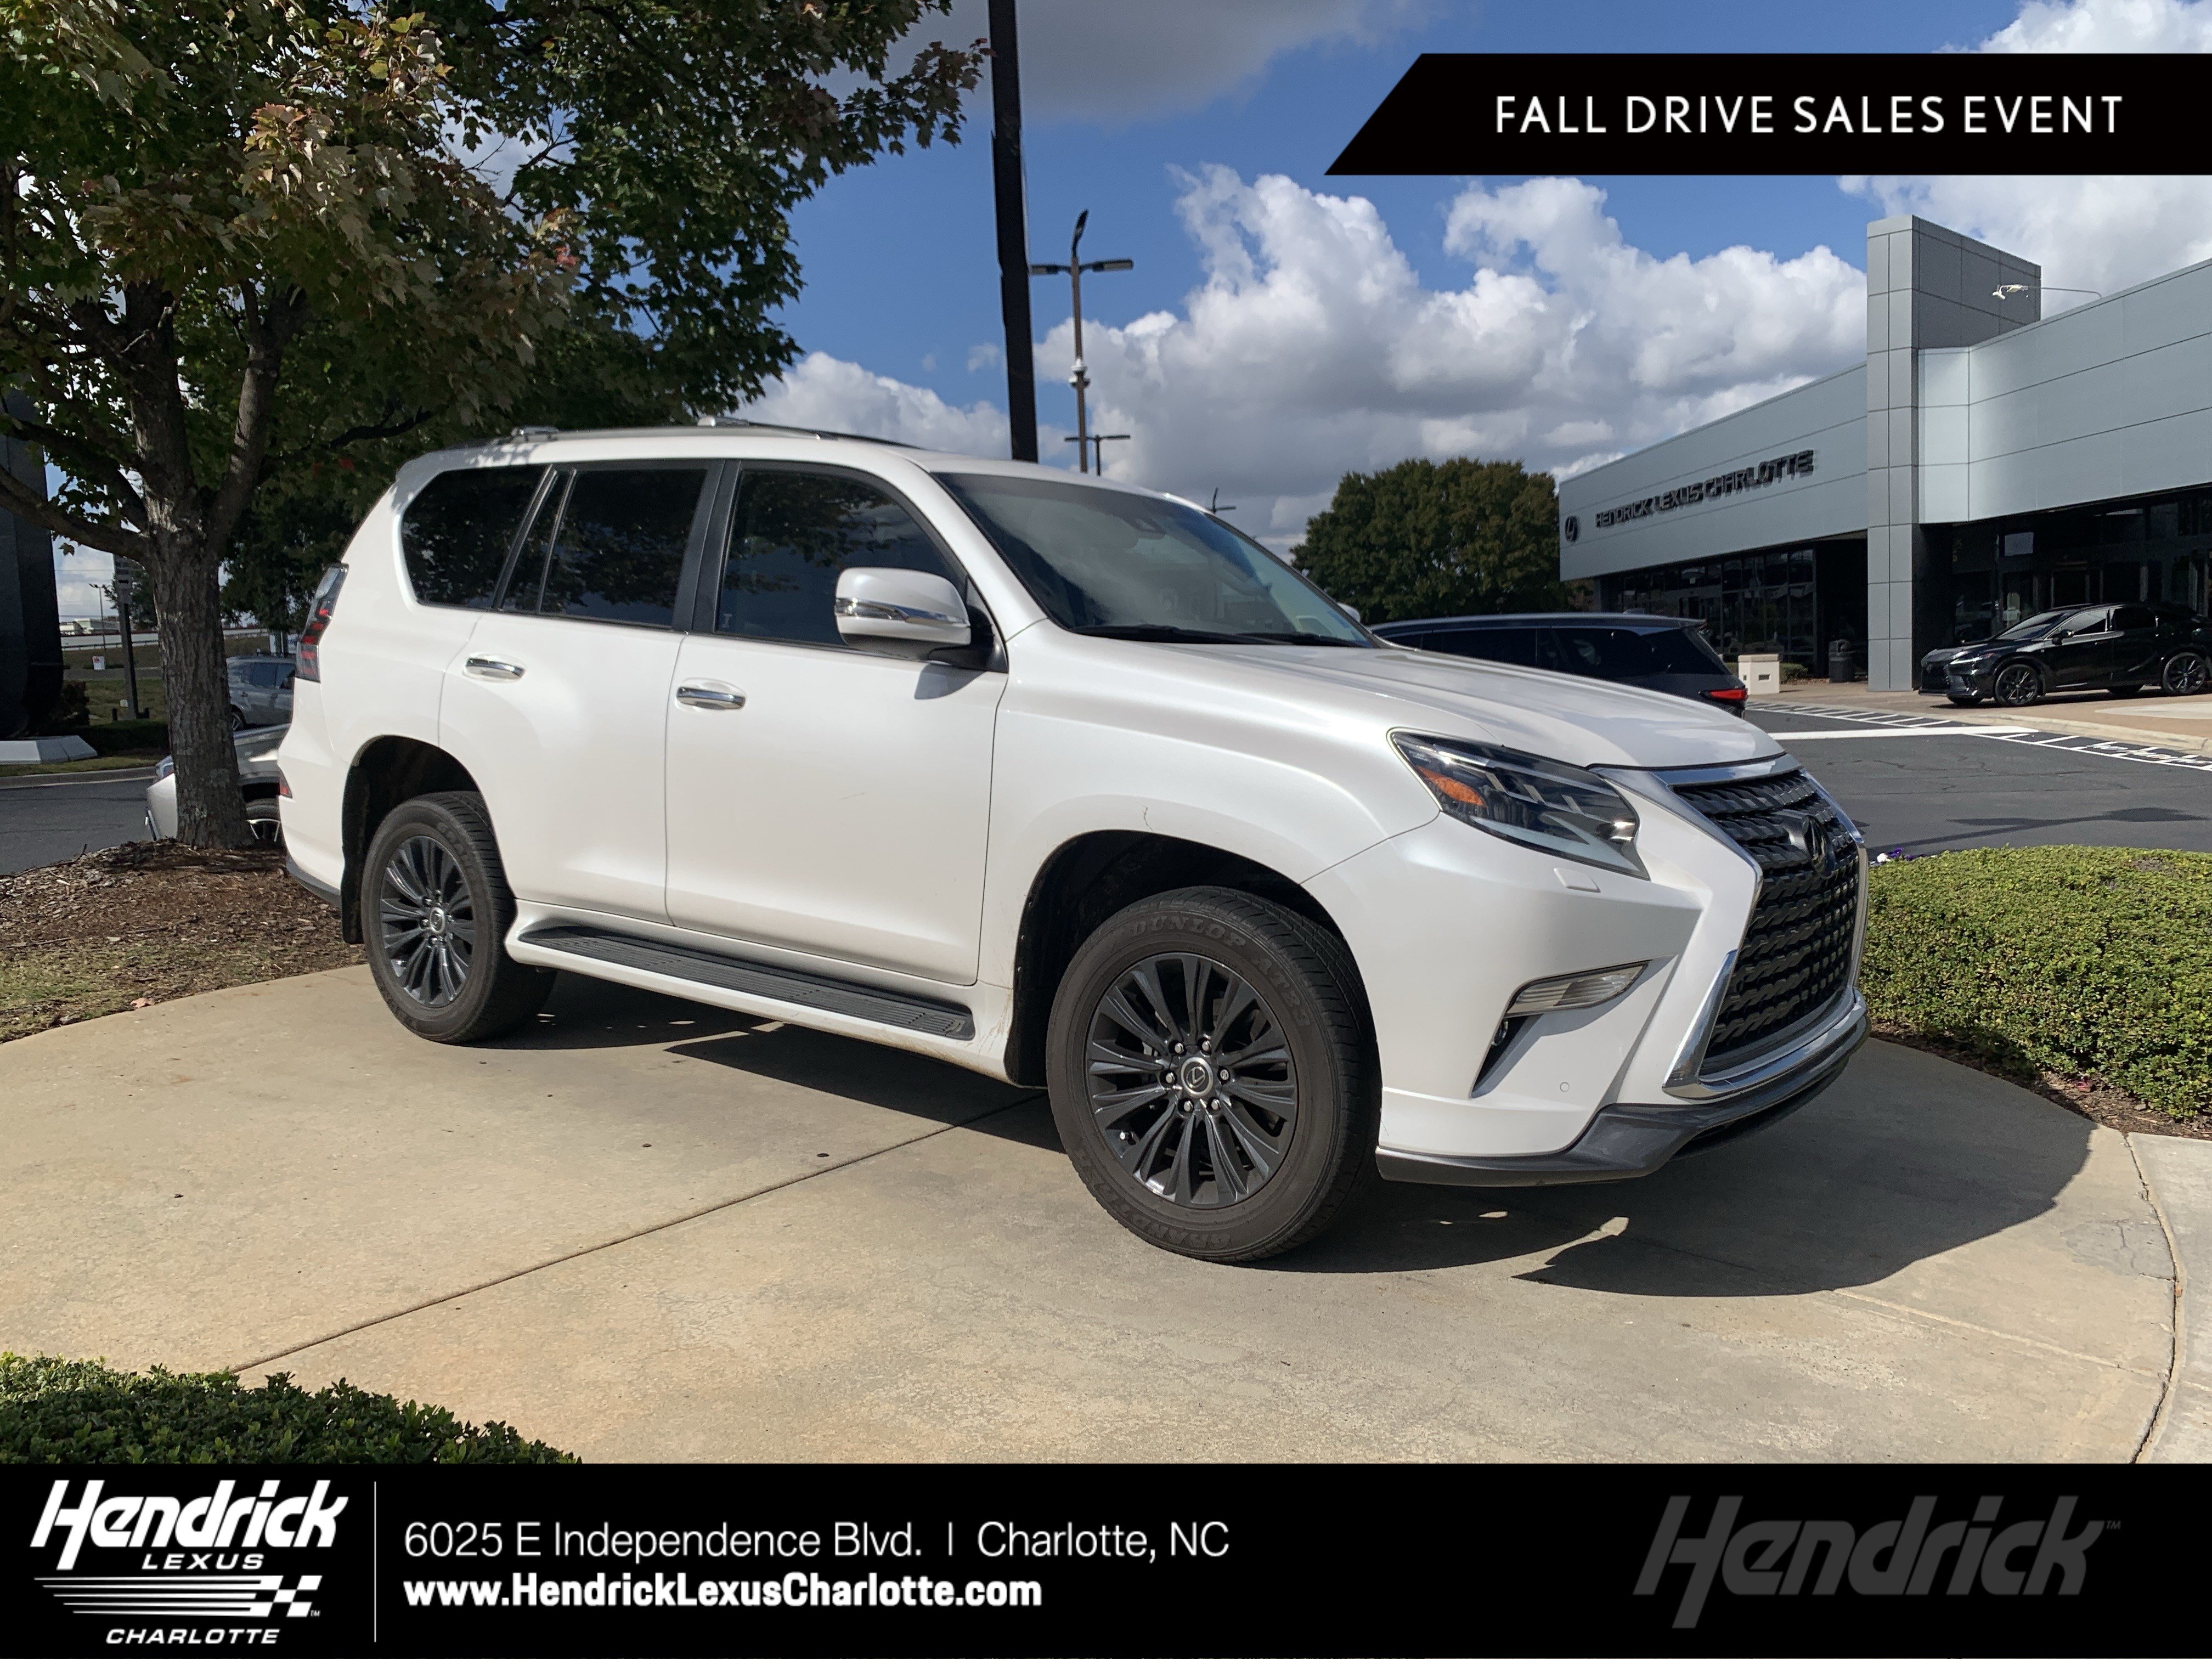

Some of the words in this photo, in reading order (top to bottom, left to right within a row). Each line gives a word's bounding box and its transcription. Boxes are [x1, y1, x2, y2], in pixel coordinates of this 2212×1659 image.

[1595, 497, 1654, 528] HENDRICK
[1655, 482, 1703, 511] LEXUS
[1703, 449, 1814, 497] CHARLOTTE
[1132, 915, 1246, 947] DUNLOP
